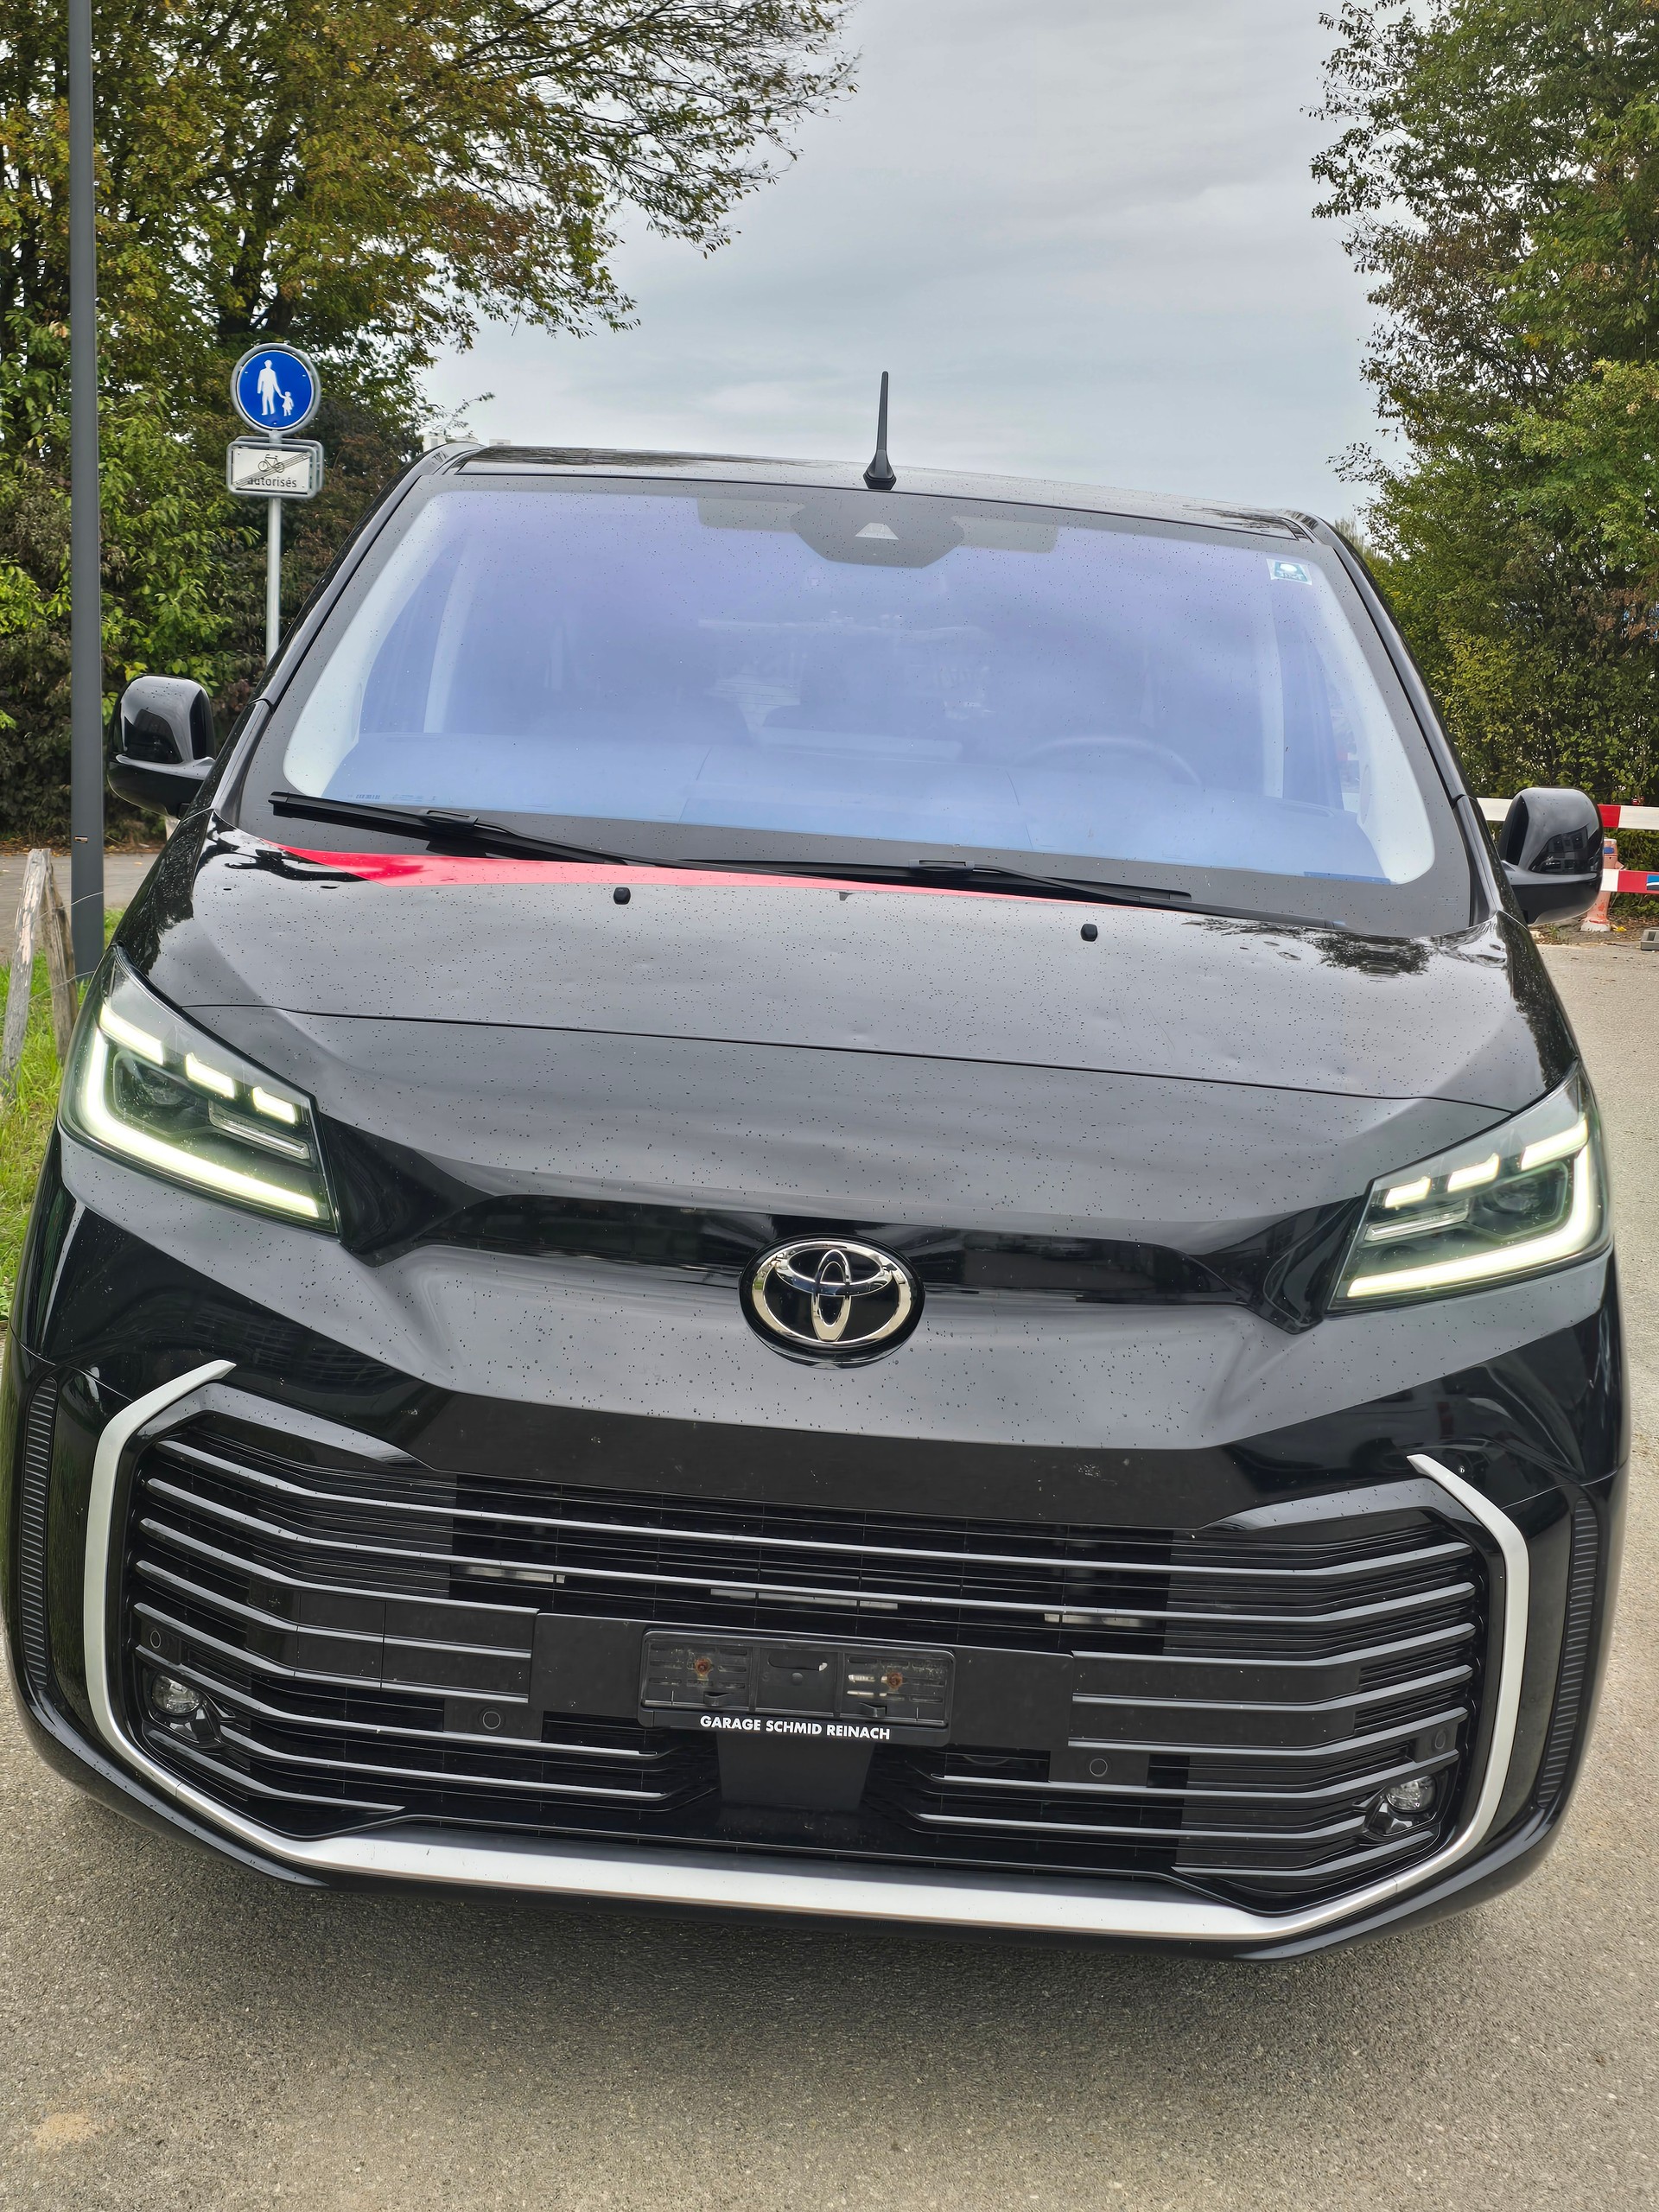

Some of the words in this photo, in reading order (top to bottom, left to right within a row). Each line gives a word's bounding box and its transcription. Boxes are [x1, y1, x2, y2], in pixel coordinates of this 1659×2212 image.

[700, 1715, 761, 1731] GARAGE
[766, 1719, 823, 1735] SCHMID
[826, 1724, 891, 1740] REINACH
